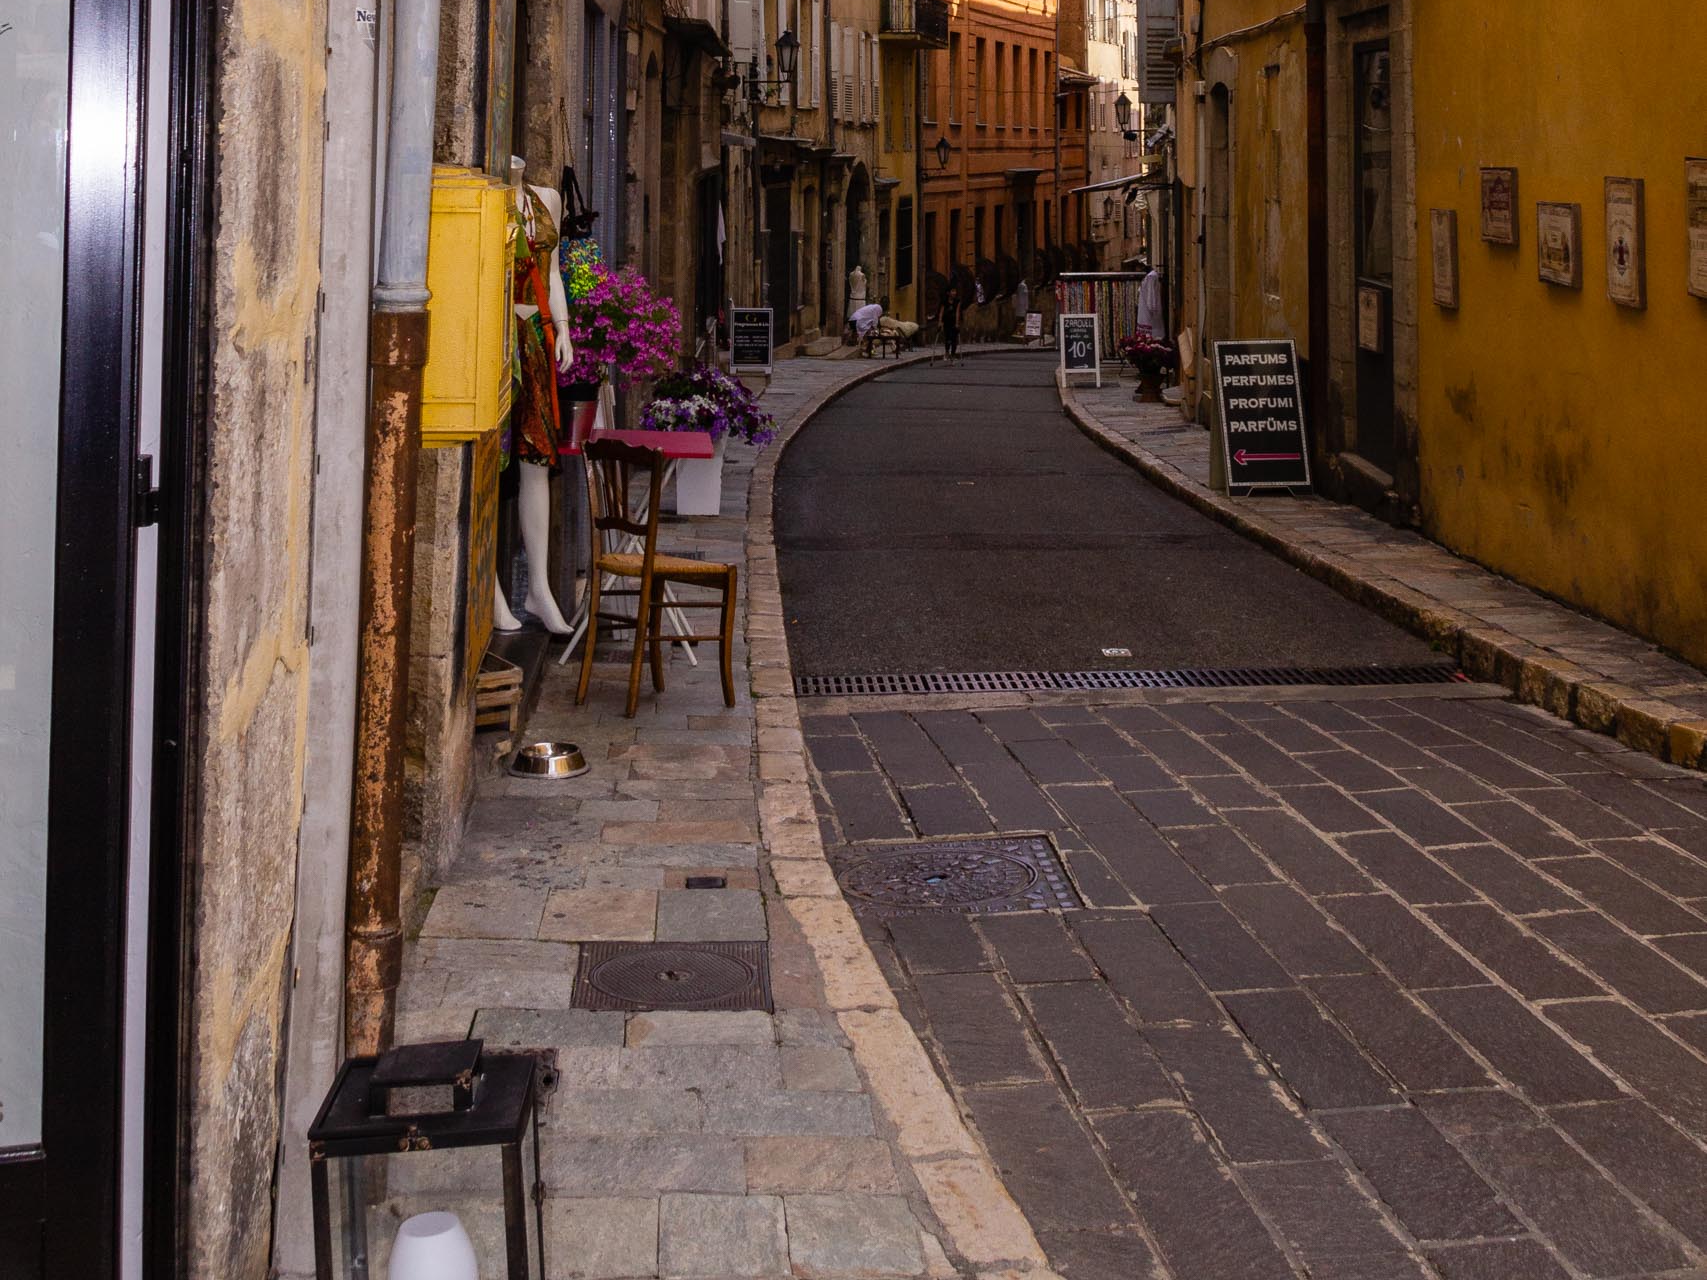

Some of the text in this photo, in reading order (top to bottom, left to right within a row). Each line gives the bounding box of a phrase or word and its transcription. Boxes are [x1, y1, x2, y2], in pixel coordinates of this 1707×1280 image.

[1224, 354, 1288, 365] PARFUMS
[1223, 375, 1294, 386] PERFUMES
[1229, 398, 1293, 409] PROFUMI
[1230, 417, 1297, 432] PARFÜMS
